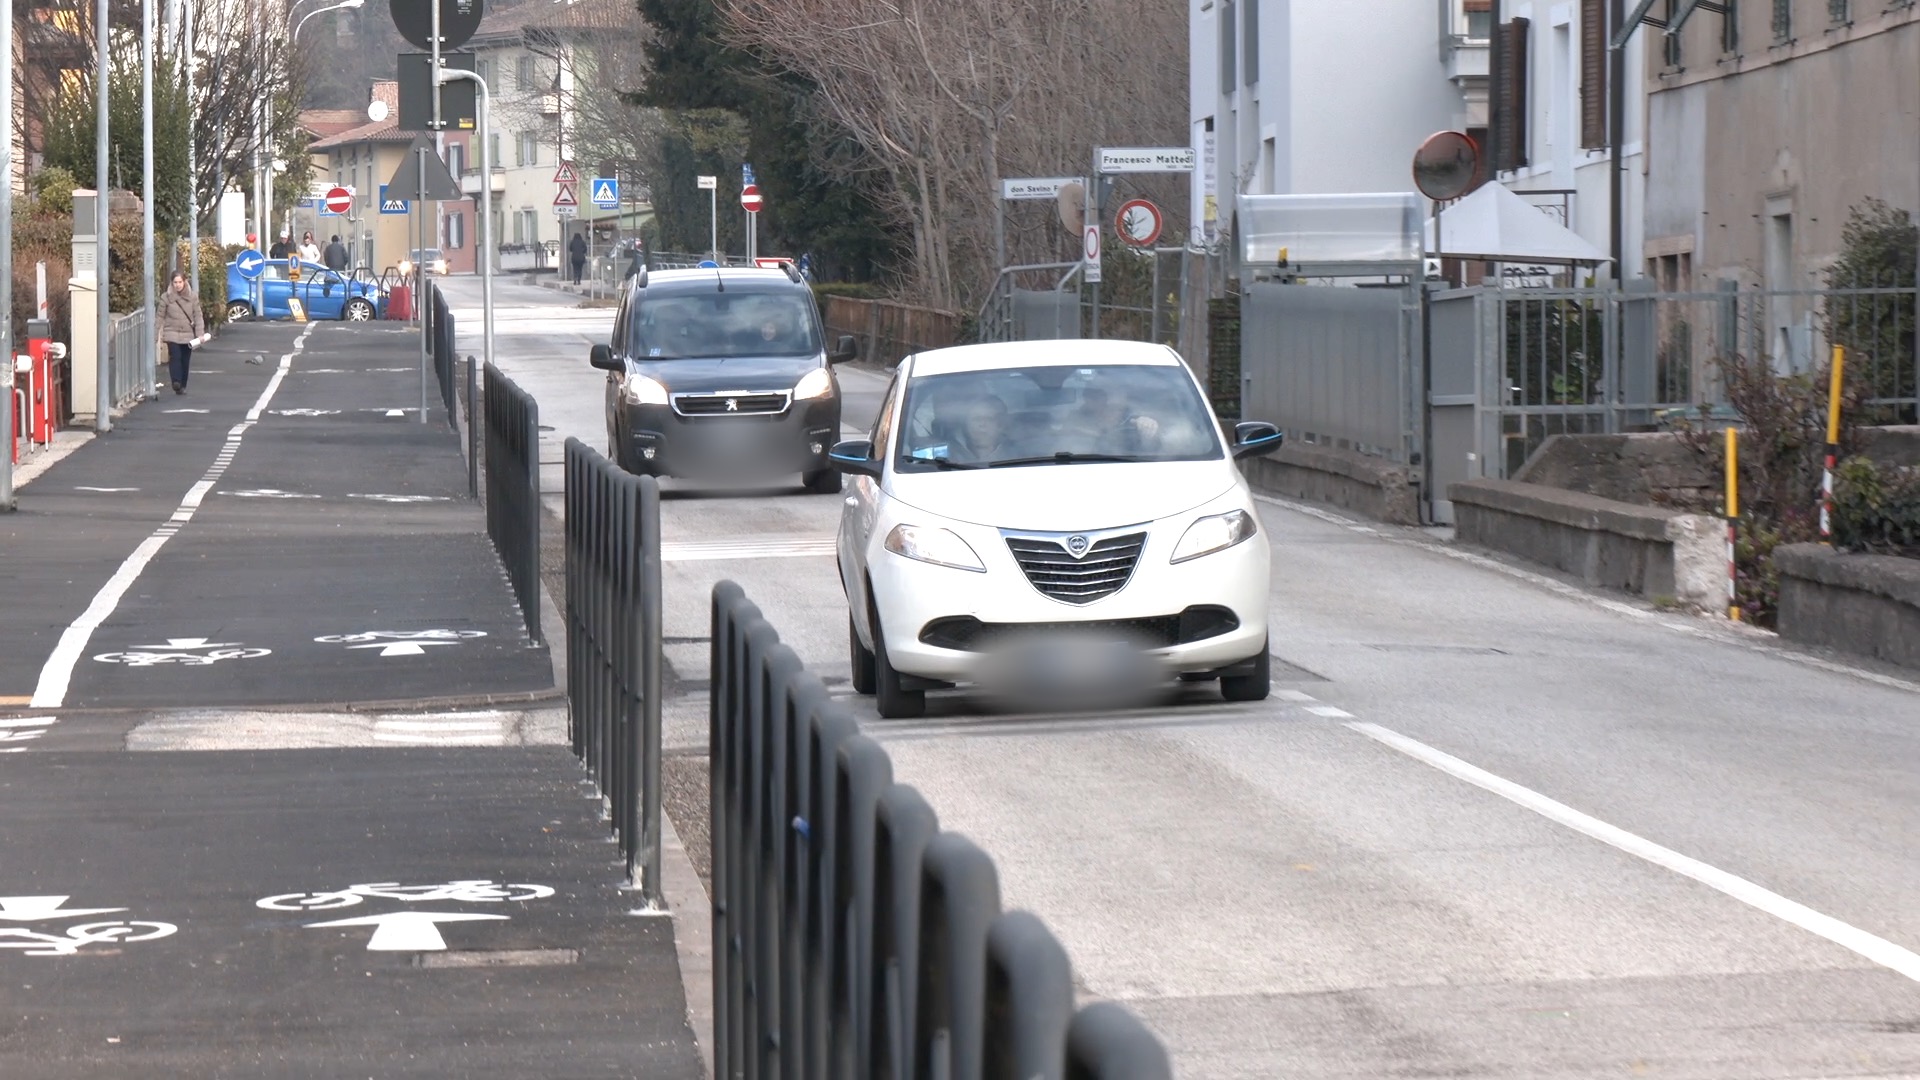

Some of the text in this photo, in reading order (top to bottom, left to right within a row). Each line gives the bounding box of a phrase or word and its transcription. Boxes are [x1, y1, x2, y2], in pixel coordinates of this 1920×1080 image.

[1103, 155, 1194, 164] Francesco Mattedi
[1026, 185, 1051, 193] Savino
